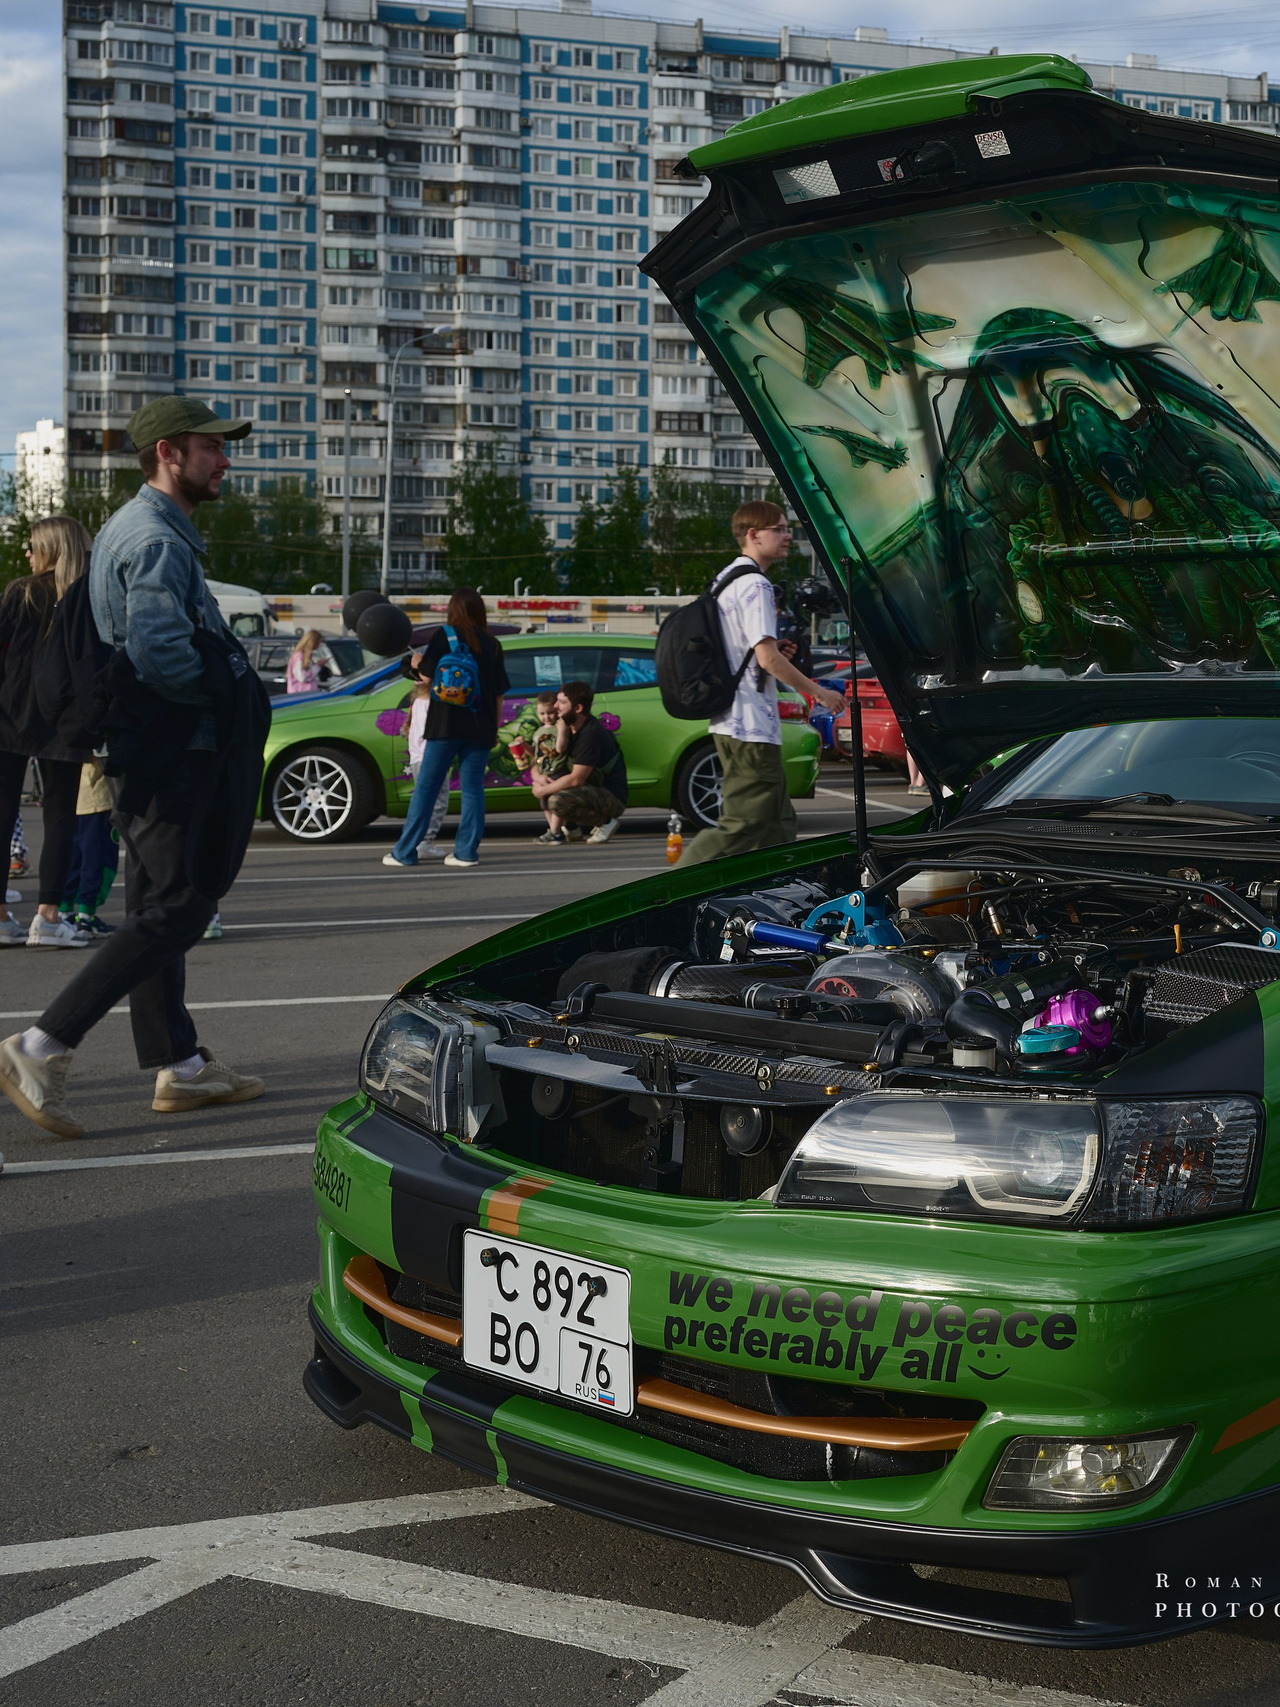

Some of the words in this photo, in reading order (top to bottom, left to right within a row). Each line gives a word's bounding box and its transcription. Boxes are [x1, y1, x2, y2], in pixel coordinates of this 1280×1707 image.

[977, 131, 1004, 144] DENSO
[533, 1260, 597, 1326] 892
[668, 1270, 733, 1312] we
[748, 1282, 884, 1332] need
[892, 1300, 1077, 1350] peace
[578, 1341, 611, 1389] 76
[663, 1314, 887, 1381] preferably
[900, 1342, 963, 1383] all
[575, 1382, 597, 1400] RUS
